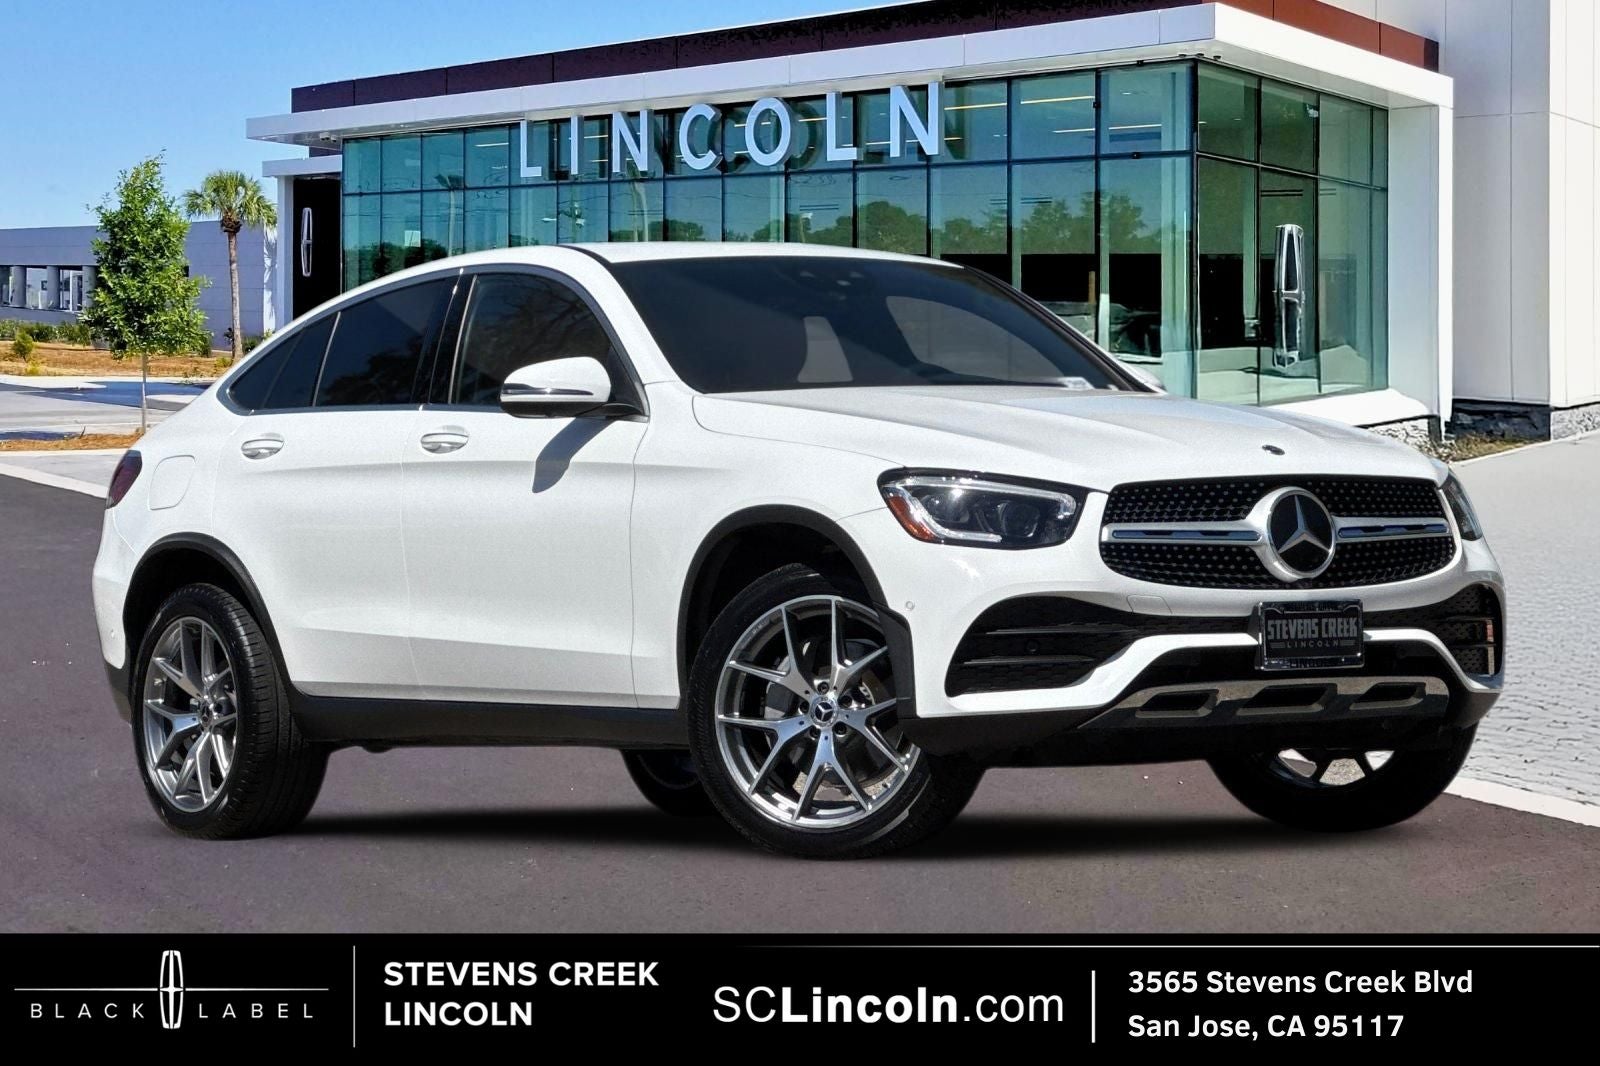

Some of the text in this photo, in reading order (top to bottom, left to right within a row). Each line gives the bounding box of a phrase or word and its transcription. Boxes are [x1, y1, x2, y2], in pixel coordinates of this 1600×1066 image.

[520, 82, 940, 178] LINCOLN
[1267, 617, 1358, 640] STEVENS CREEK
[1286, 640, 1339, 649] LINCOLN
